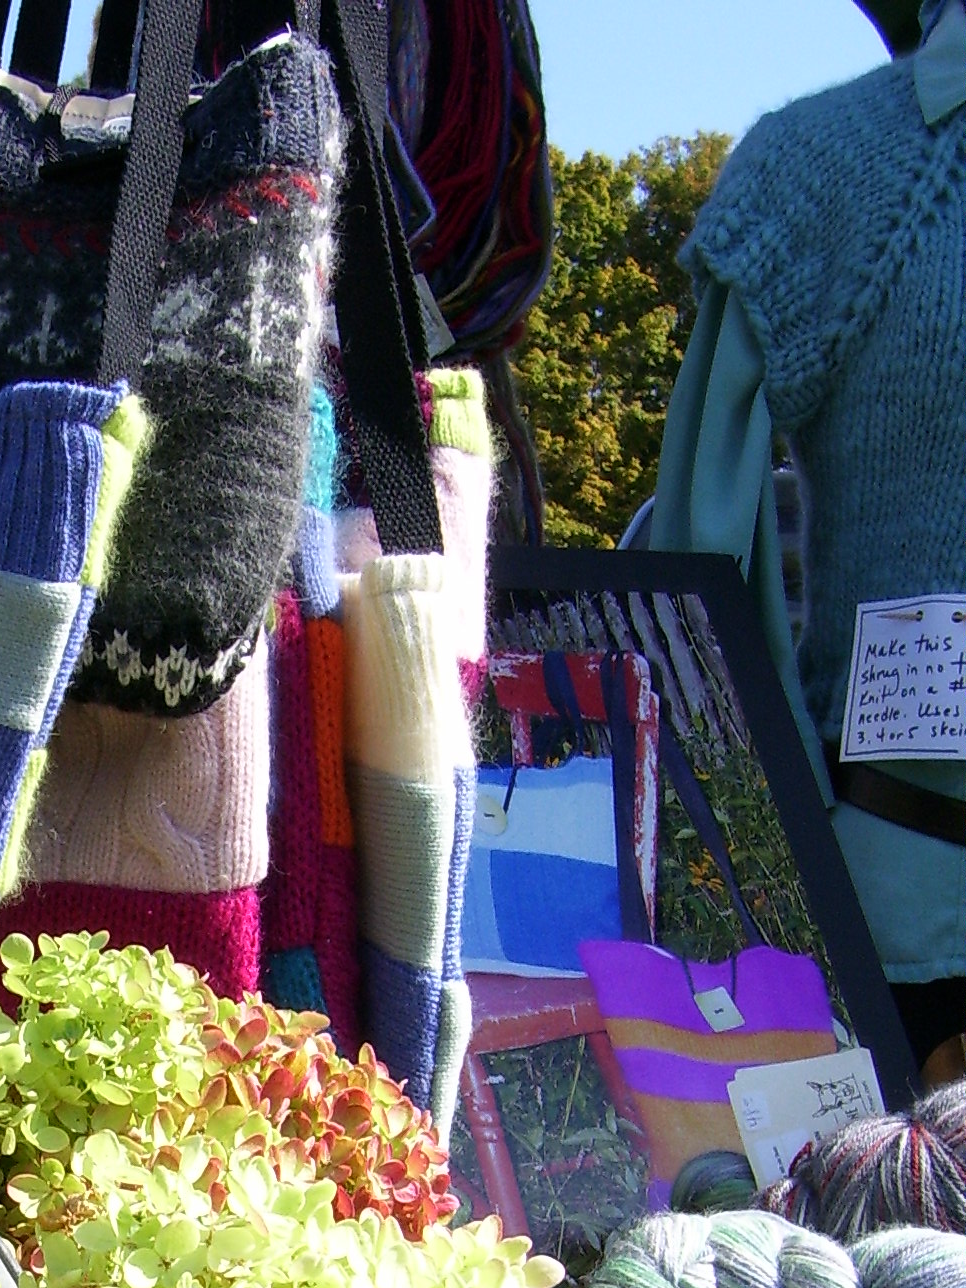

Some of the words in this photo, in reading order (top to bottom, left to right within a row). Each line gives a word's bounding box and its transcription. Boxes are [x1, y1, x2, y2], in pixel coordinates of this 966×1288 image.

[915, 633, 952, 654] this
[861, 664, 900, 695] shrug
[906, 663, 918, 676] in
[926, 664, 944, 674] no
[901, 686, 916, 698] on
[927, 686, 939, 695] a
[857, 706, 907, 725] needle.
[917, 702, 960, 718] Uses
[876, 727, 885, 743] 4
[889, 732, 904, 741] or
[908, 726, 919, 739] 5
